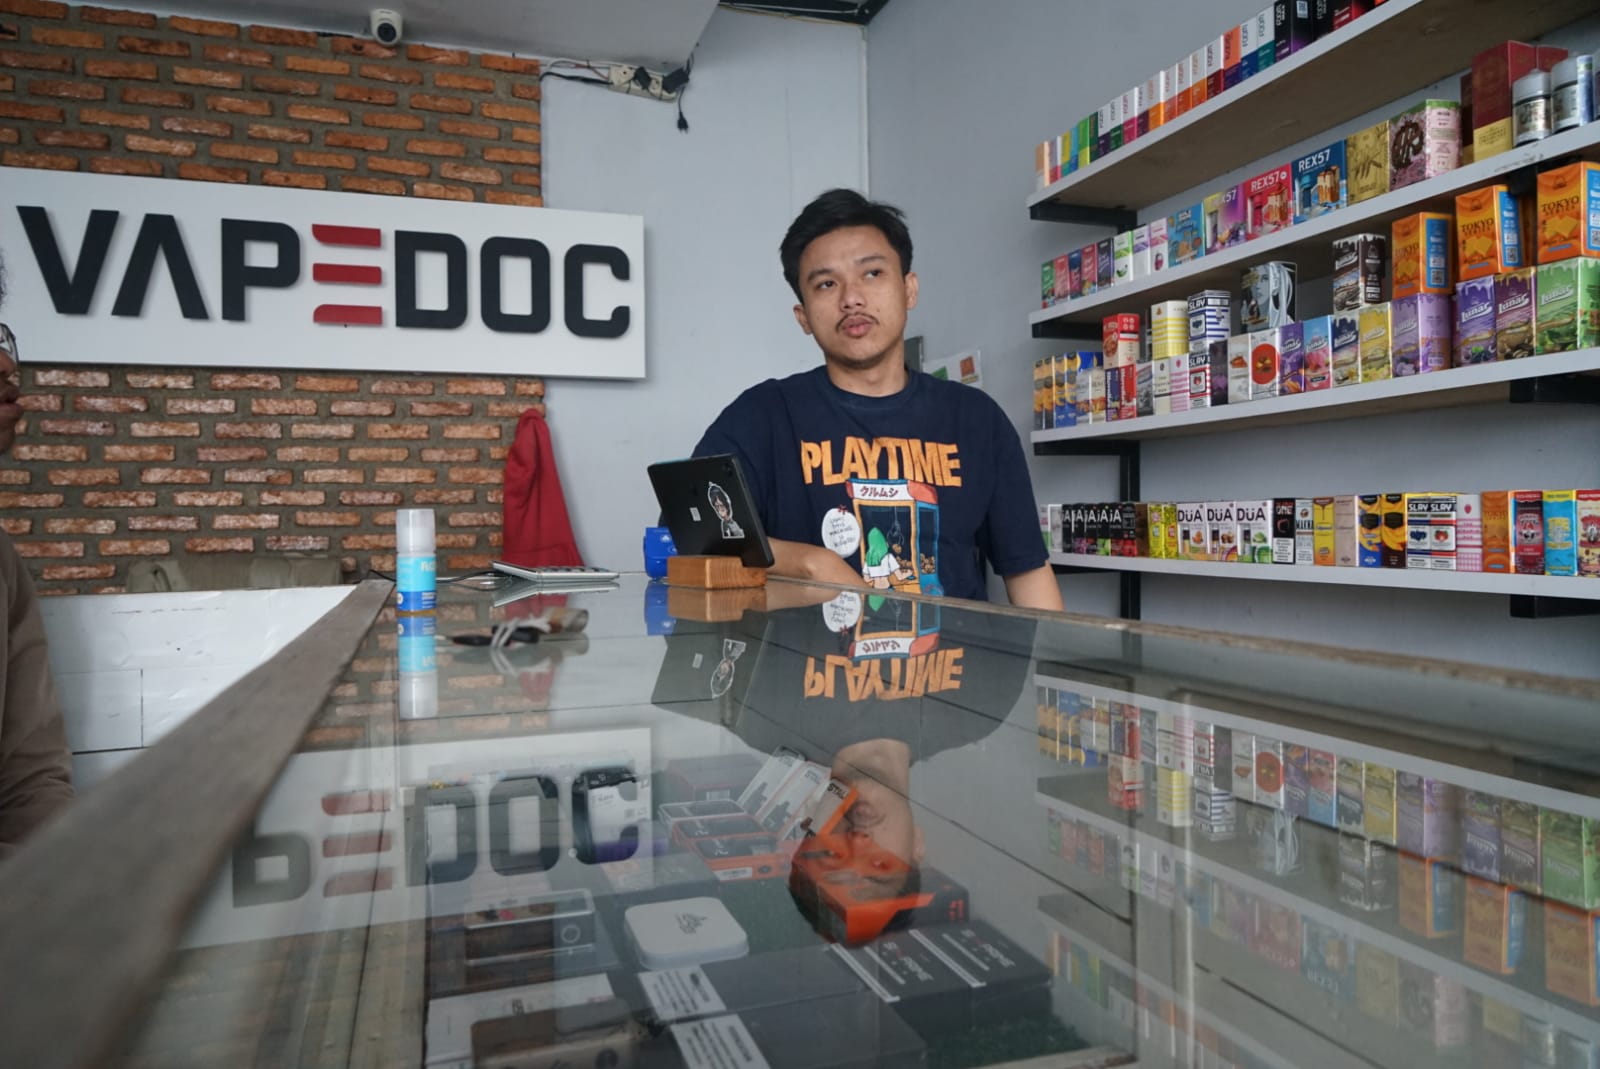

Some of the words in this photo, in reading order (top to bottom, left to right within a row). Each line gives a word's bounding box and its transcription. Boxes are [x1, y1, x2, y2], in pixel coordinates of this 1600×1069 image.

[1298, 149, 1330, 173] REX57
[1250, 171, 1280, 192] REX57
[1541, 195, 1580, 212] TOKYO
[1461, 218, 1495, 233] TOKYO
[16, 205, 630, 340] VAPEDOC
[1188, 300, 1206, 310] SLAY
[1189, 356, 1206, 367] SLAY
[801, 436, 962, 487] PLAYTIME
[1408, 503, 1429, 511] SLAY
[1430, 503, 1452, 512] SLAY
